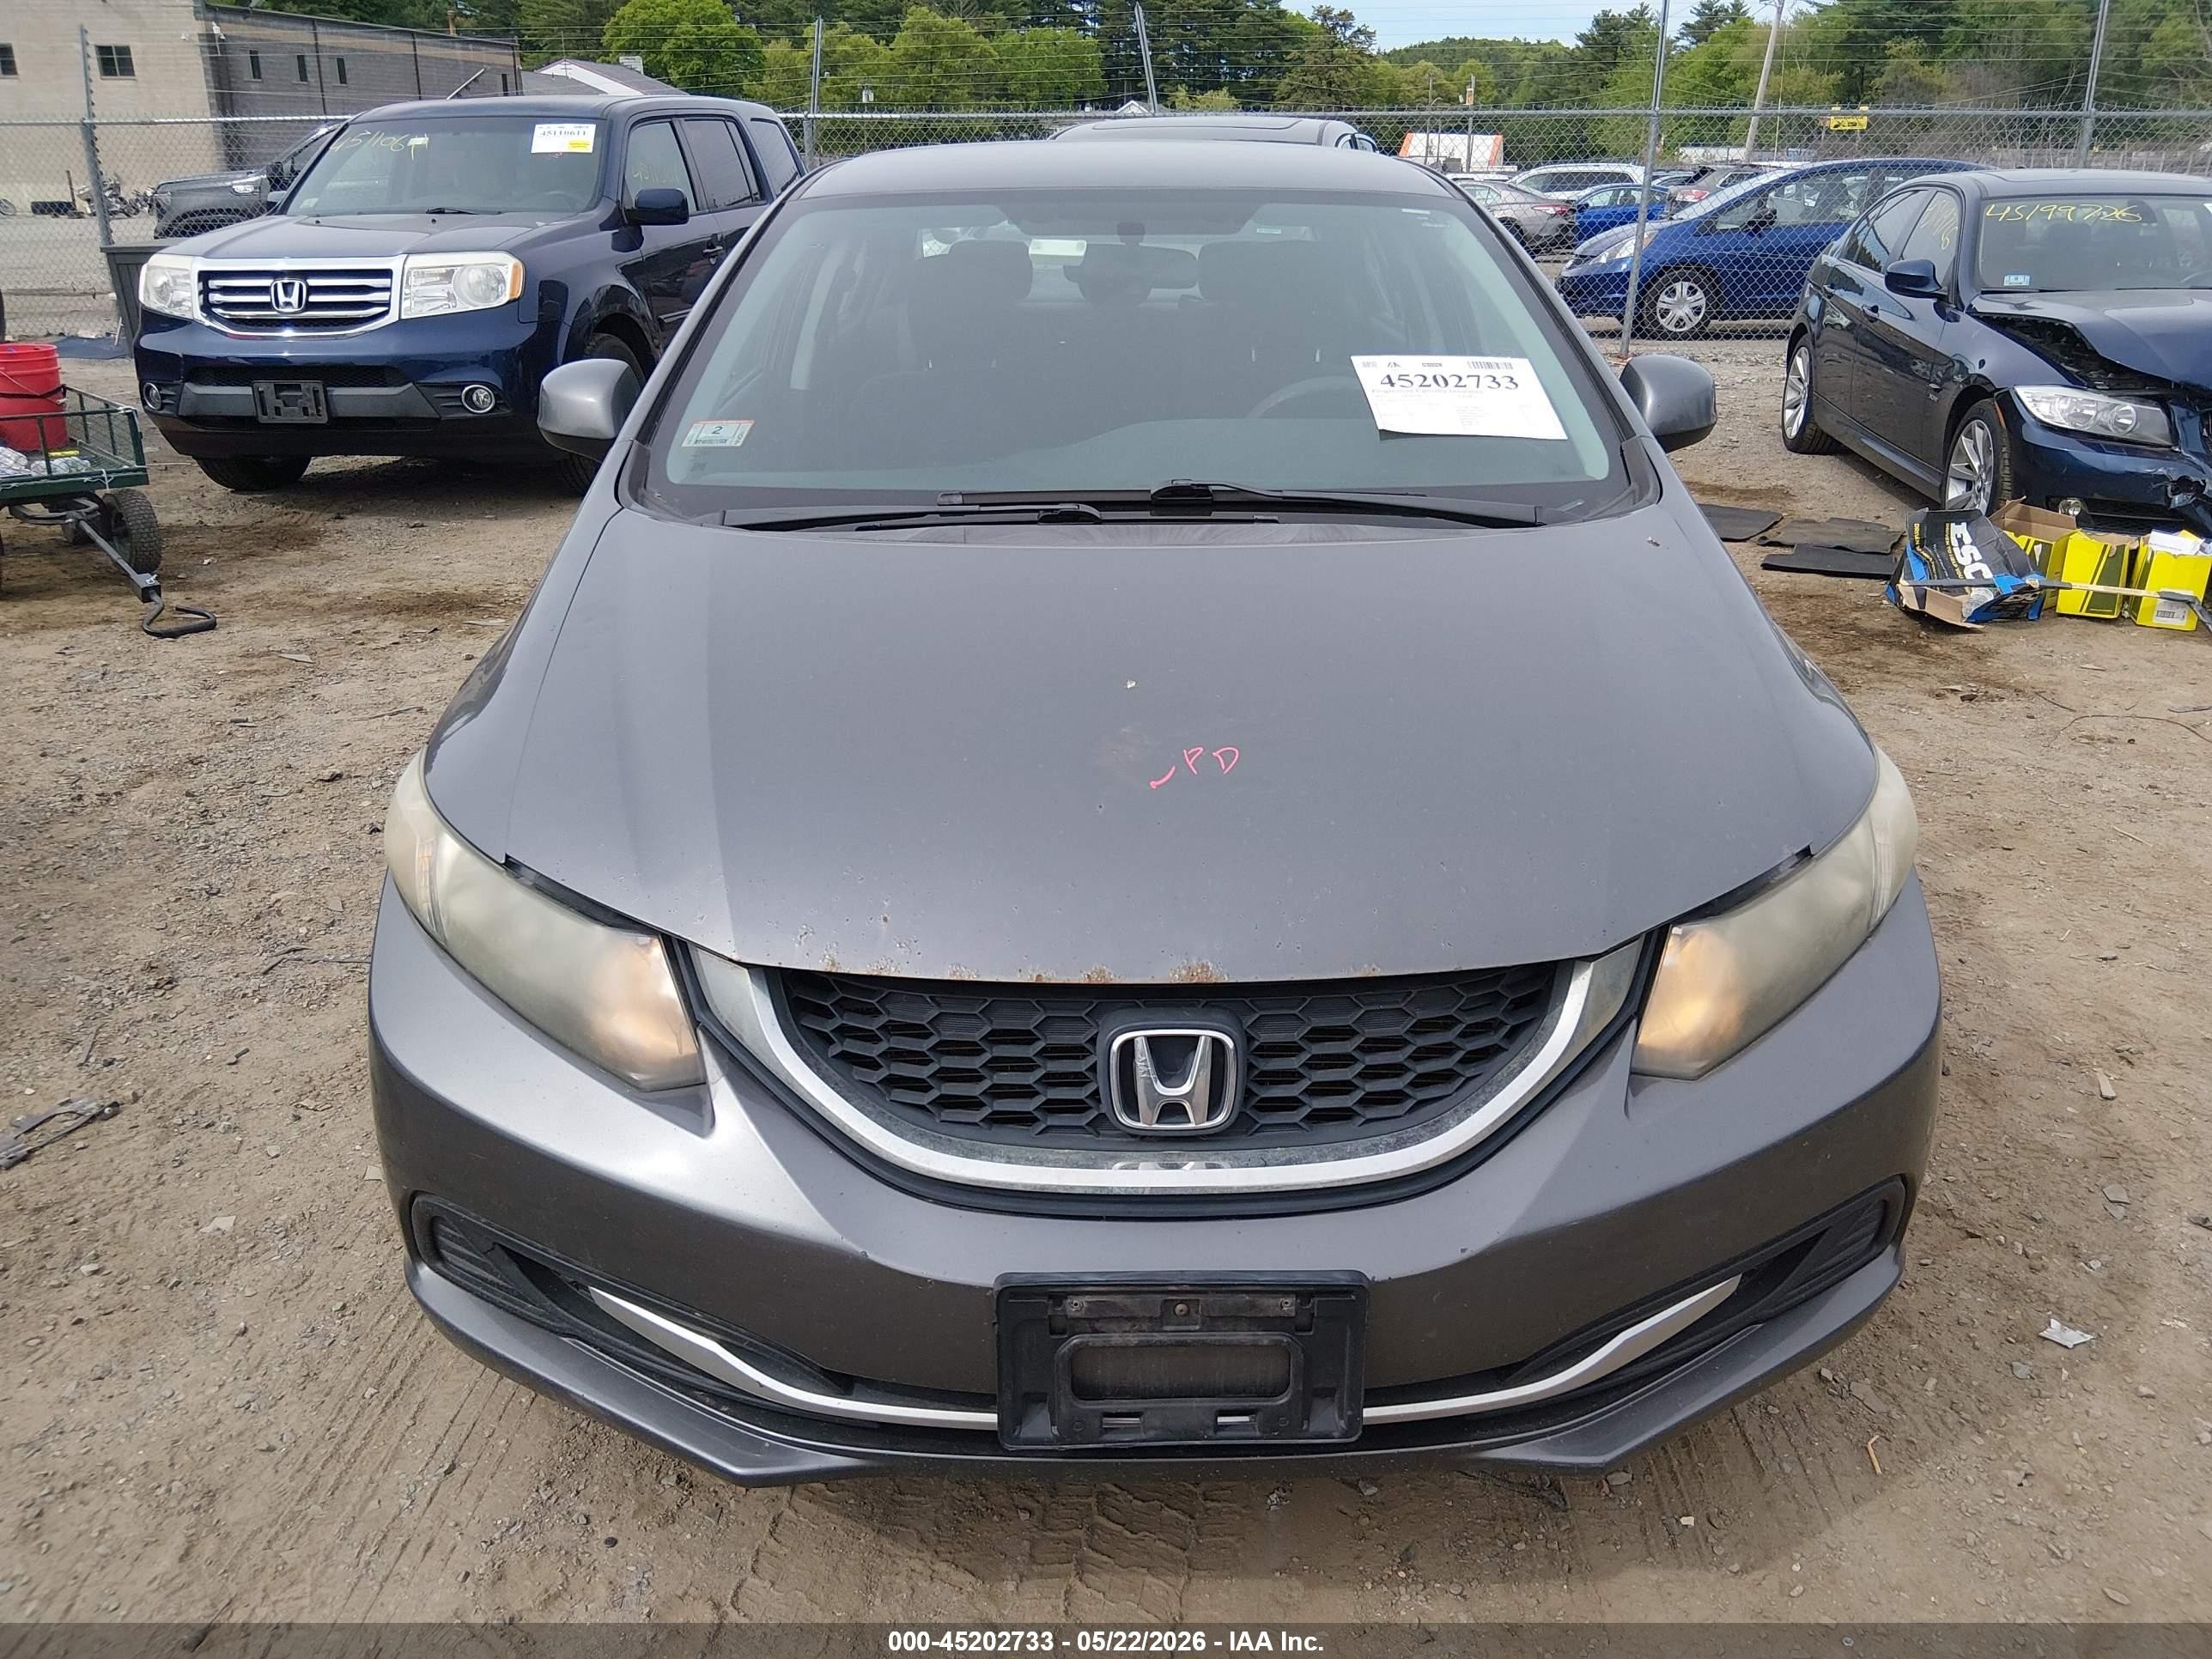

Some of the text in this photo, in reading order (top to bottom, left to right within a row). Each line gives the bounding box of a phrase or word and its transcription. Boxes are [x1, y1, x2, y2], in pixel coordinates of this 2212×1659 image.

[1985, 204, 2142, 222] 45199726
[1380, 374, 1518, 390] 45202733
[711, 426, 723, 434] 2
